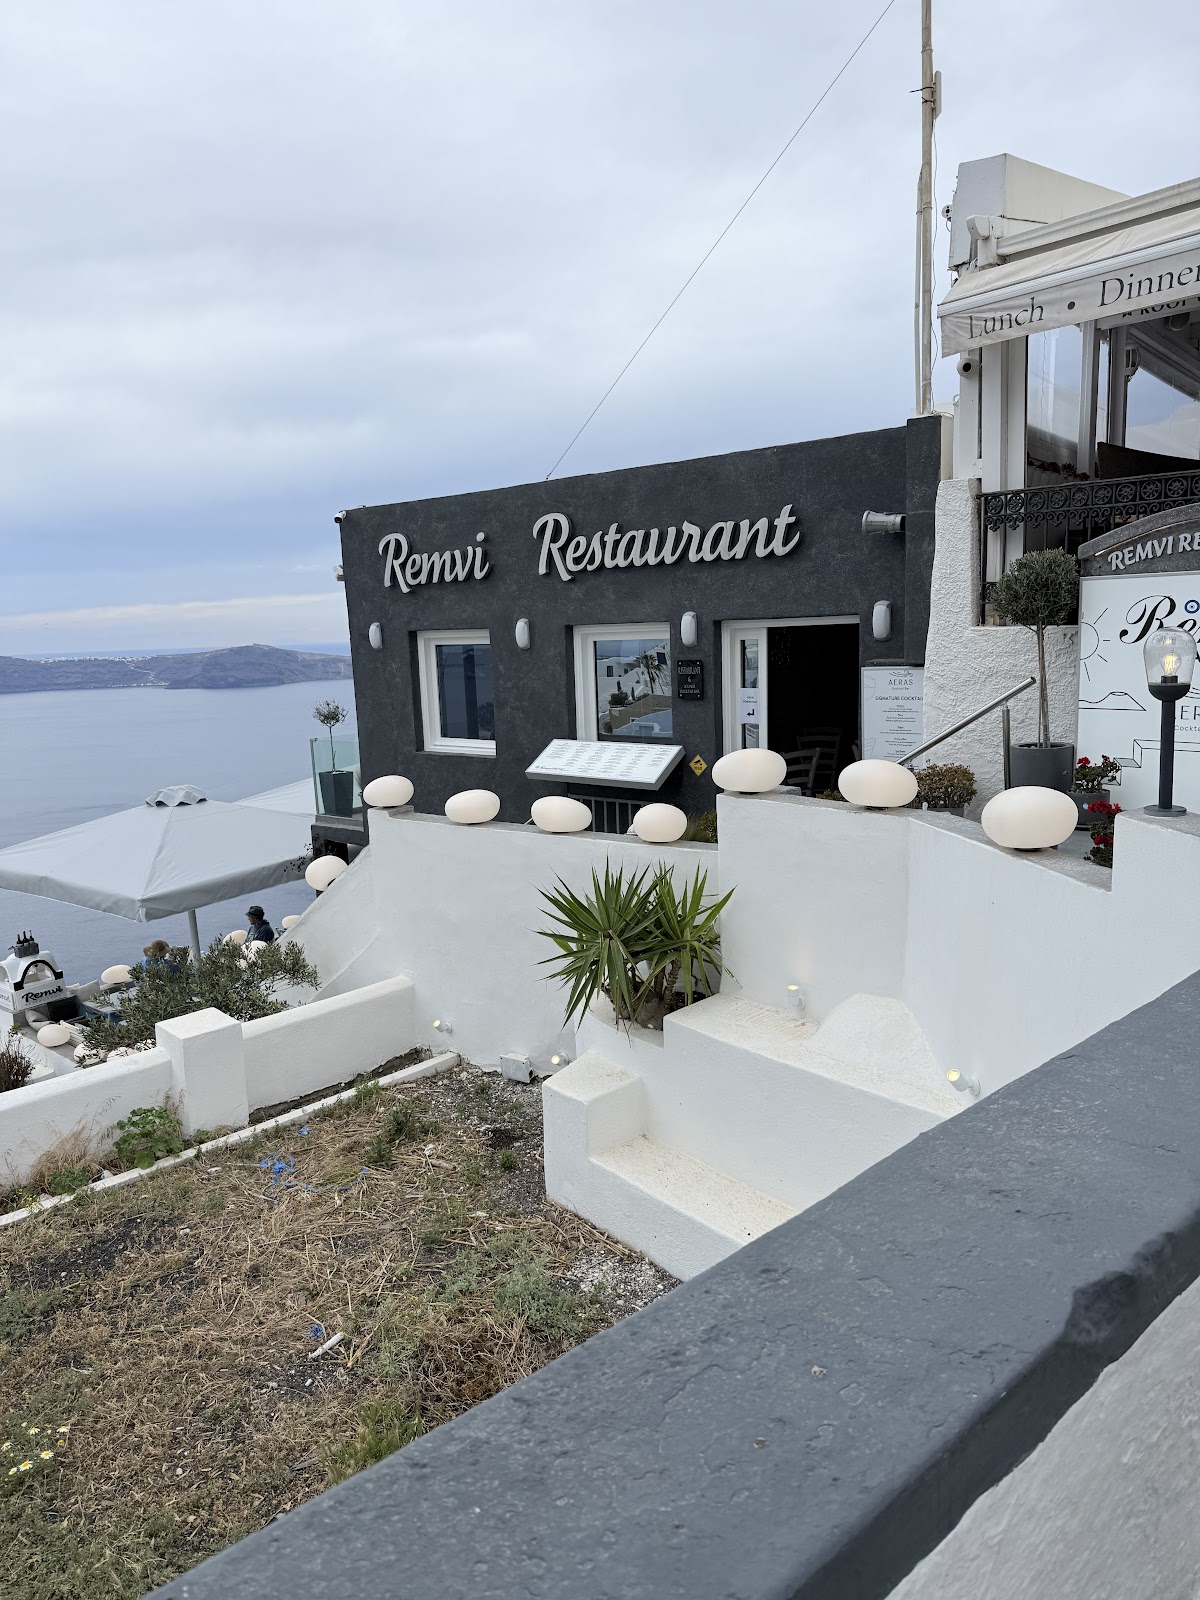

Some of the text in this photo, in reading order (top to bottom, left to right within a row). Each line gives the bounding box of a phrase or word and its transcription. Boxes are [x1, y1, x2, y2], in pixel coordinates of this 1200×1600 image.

[967, 296, 1045, 340] Lunch
[378, 503, 801, 594] Remvi Restaurant
[1107, 535, 1175, 571] REMVI
[888, 678, 914, 686] AERAS
